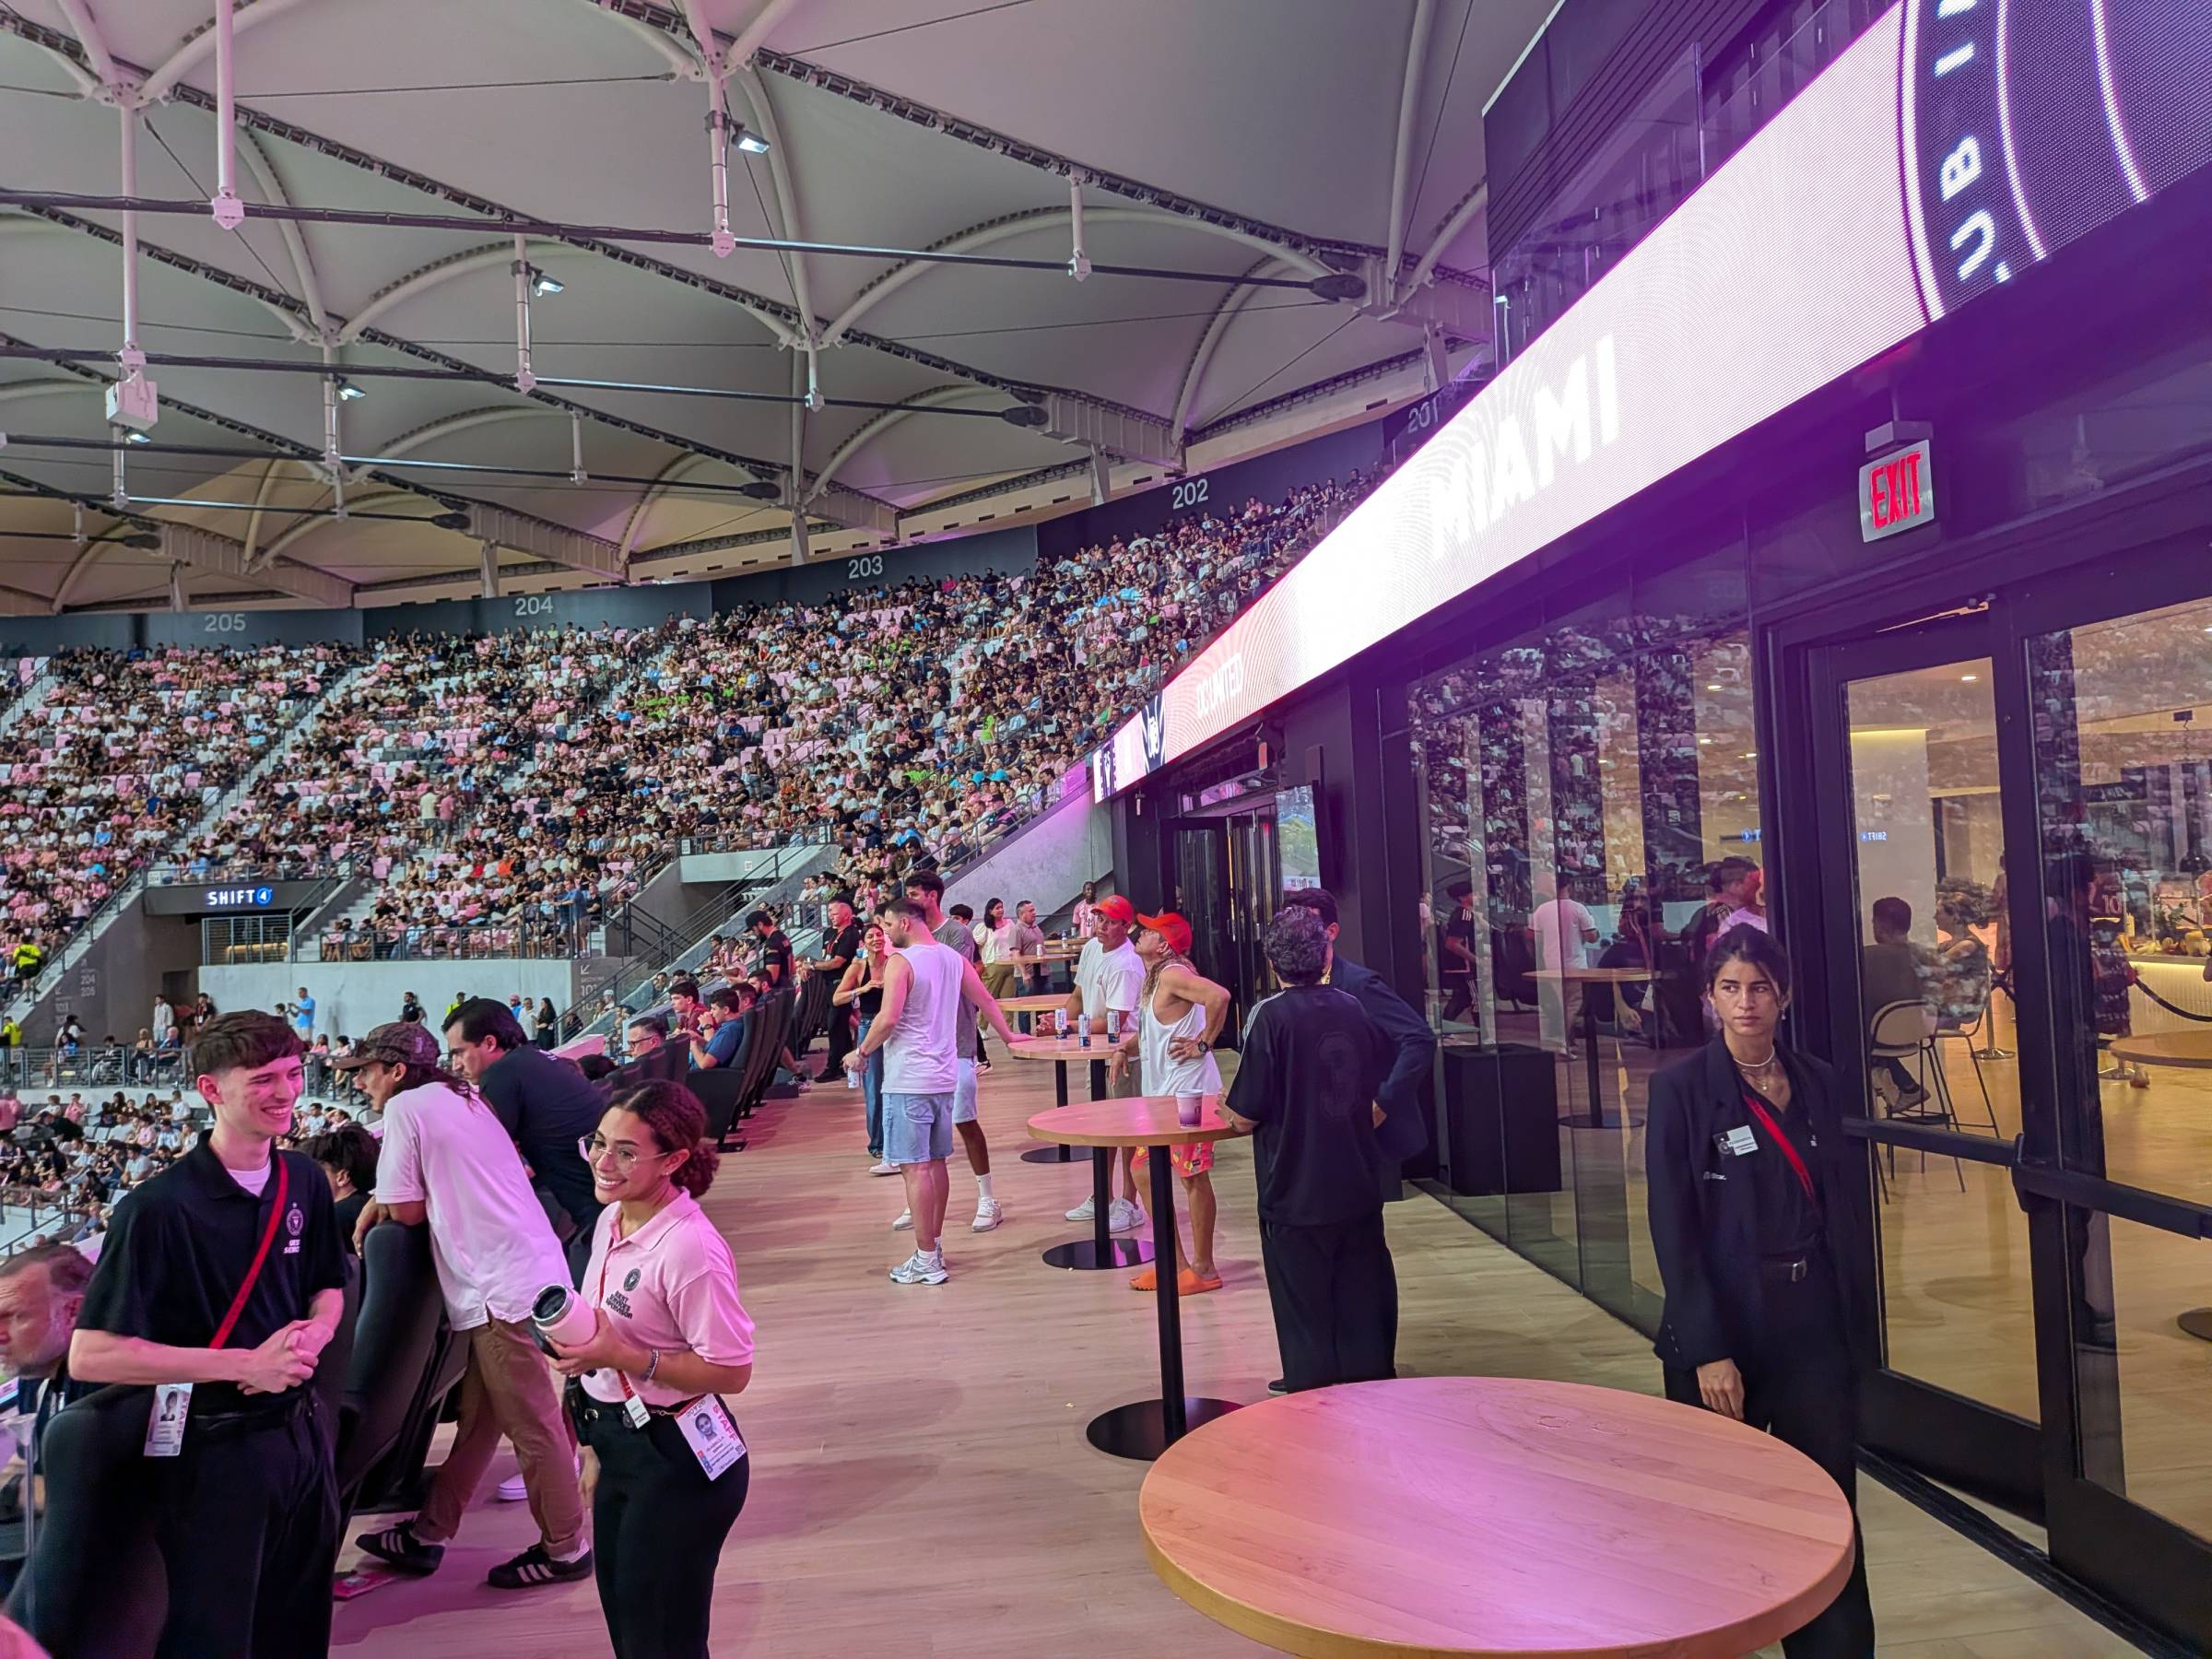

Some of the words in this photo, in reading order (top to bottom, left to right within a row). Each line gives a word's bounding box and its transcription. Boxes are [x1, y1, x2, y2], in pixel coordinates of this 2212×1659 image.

[1407, 396, 1438, 433] 201
[1431, 332, 1621, 561] MIAMI
[1172, 478, 1208, 509] 202
[1870, 451, 1922, 529] EXIT
[848, 555, 883, 579] 203
[205, 613, 246, 632] 205
[515, 595, 553, 616] 204
[712, 1404, 738, 1441] STAFF
